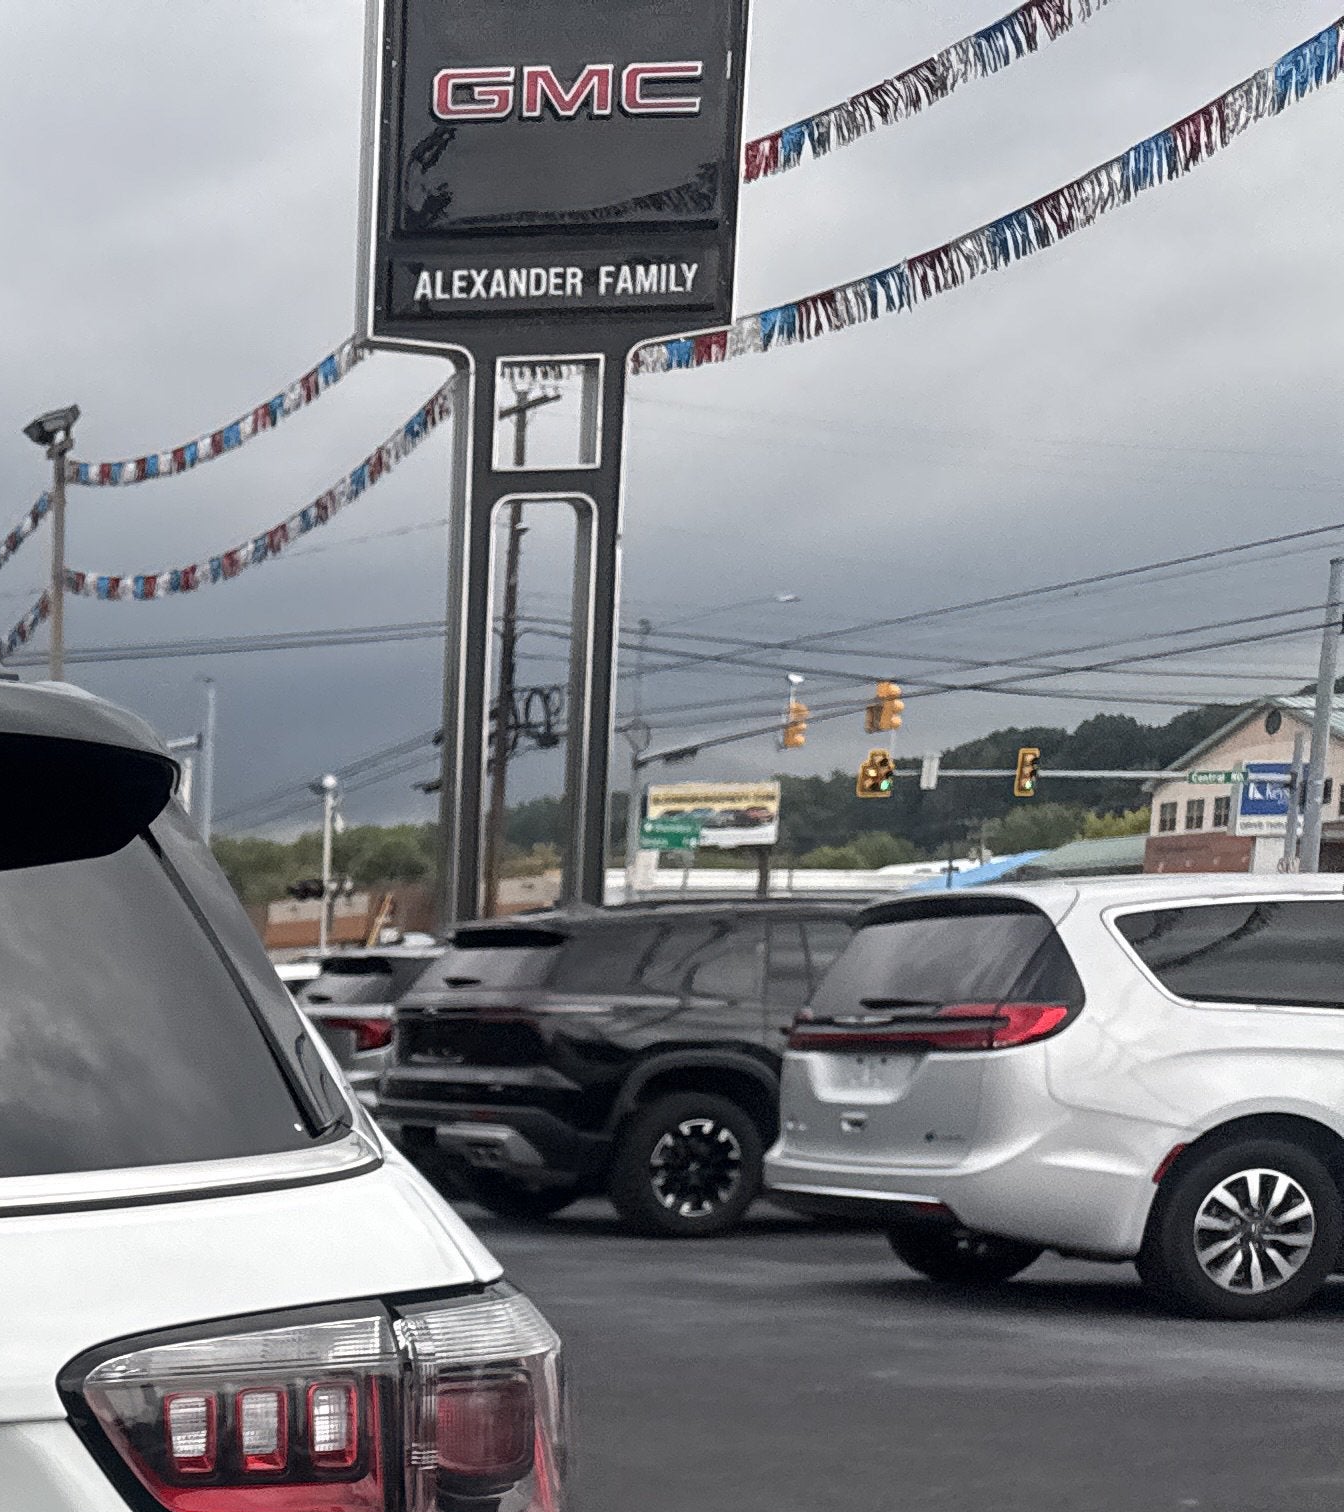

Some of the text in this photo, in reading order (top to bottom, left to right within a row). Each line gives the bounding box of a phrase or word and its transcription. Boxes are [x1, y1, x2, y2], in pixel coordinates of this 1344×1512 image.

[432, 61, 703, 120] GMC
[414, 263, 699, 301] ALEXANDER FAMILY
